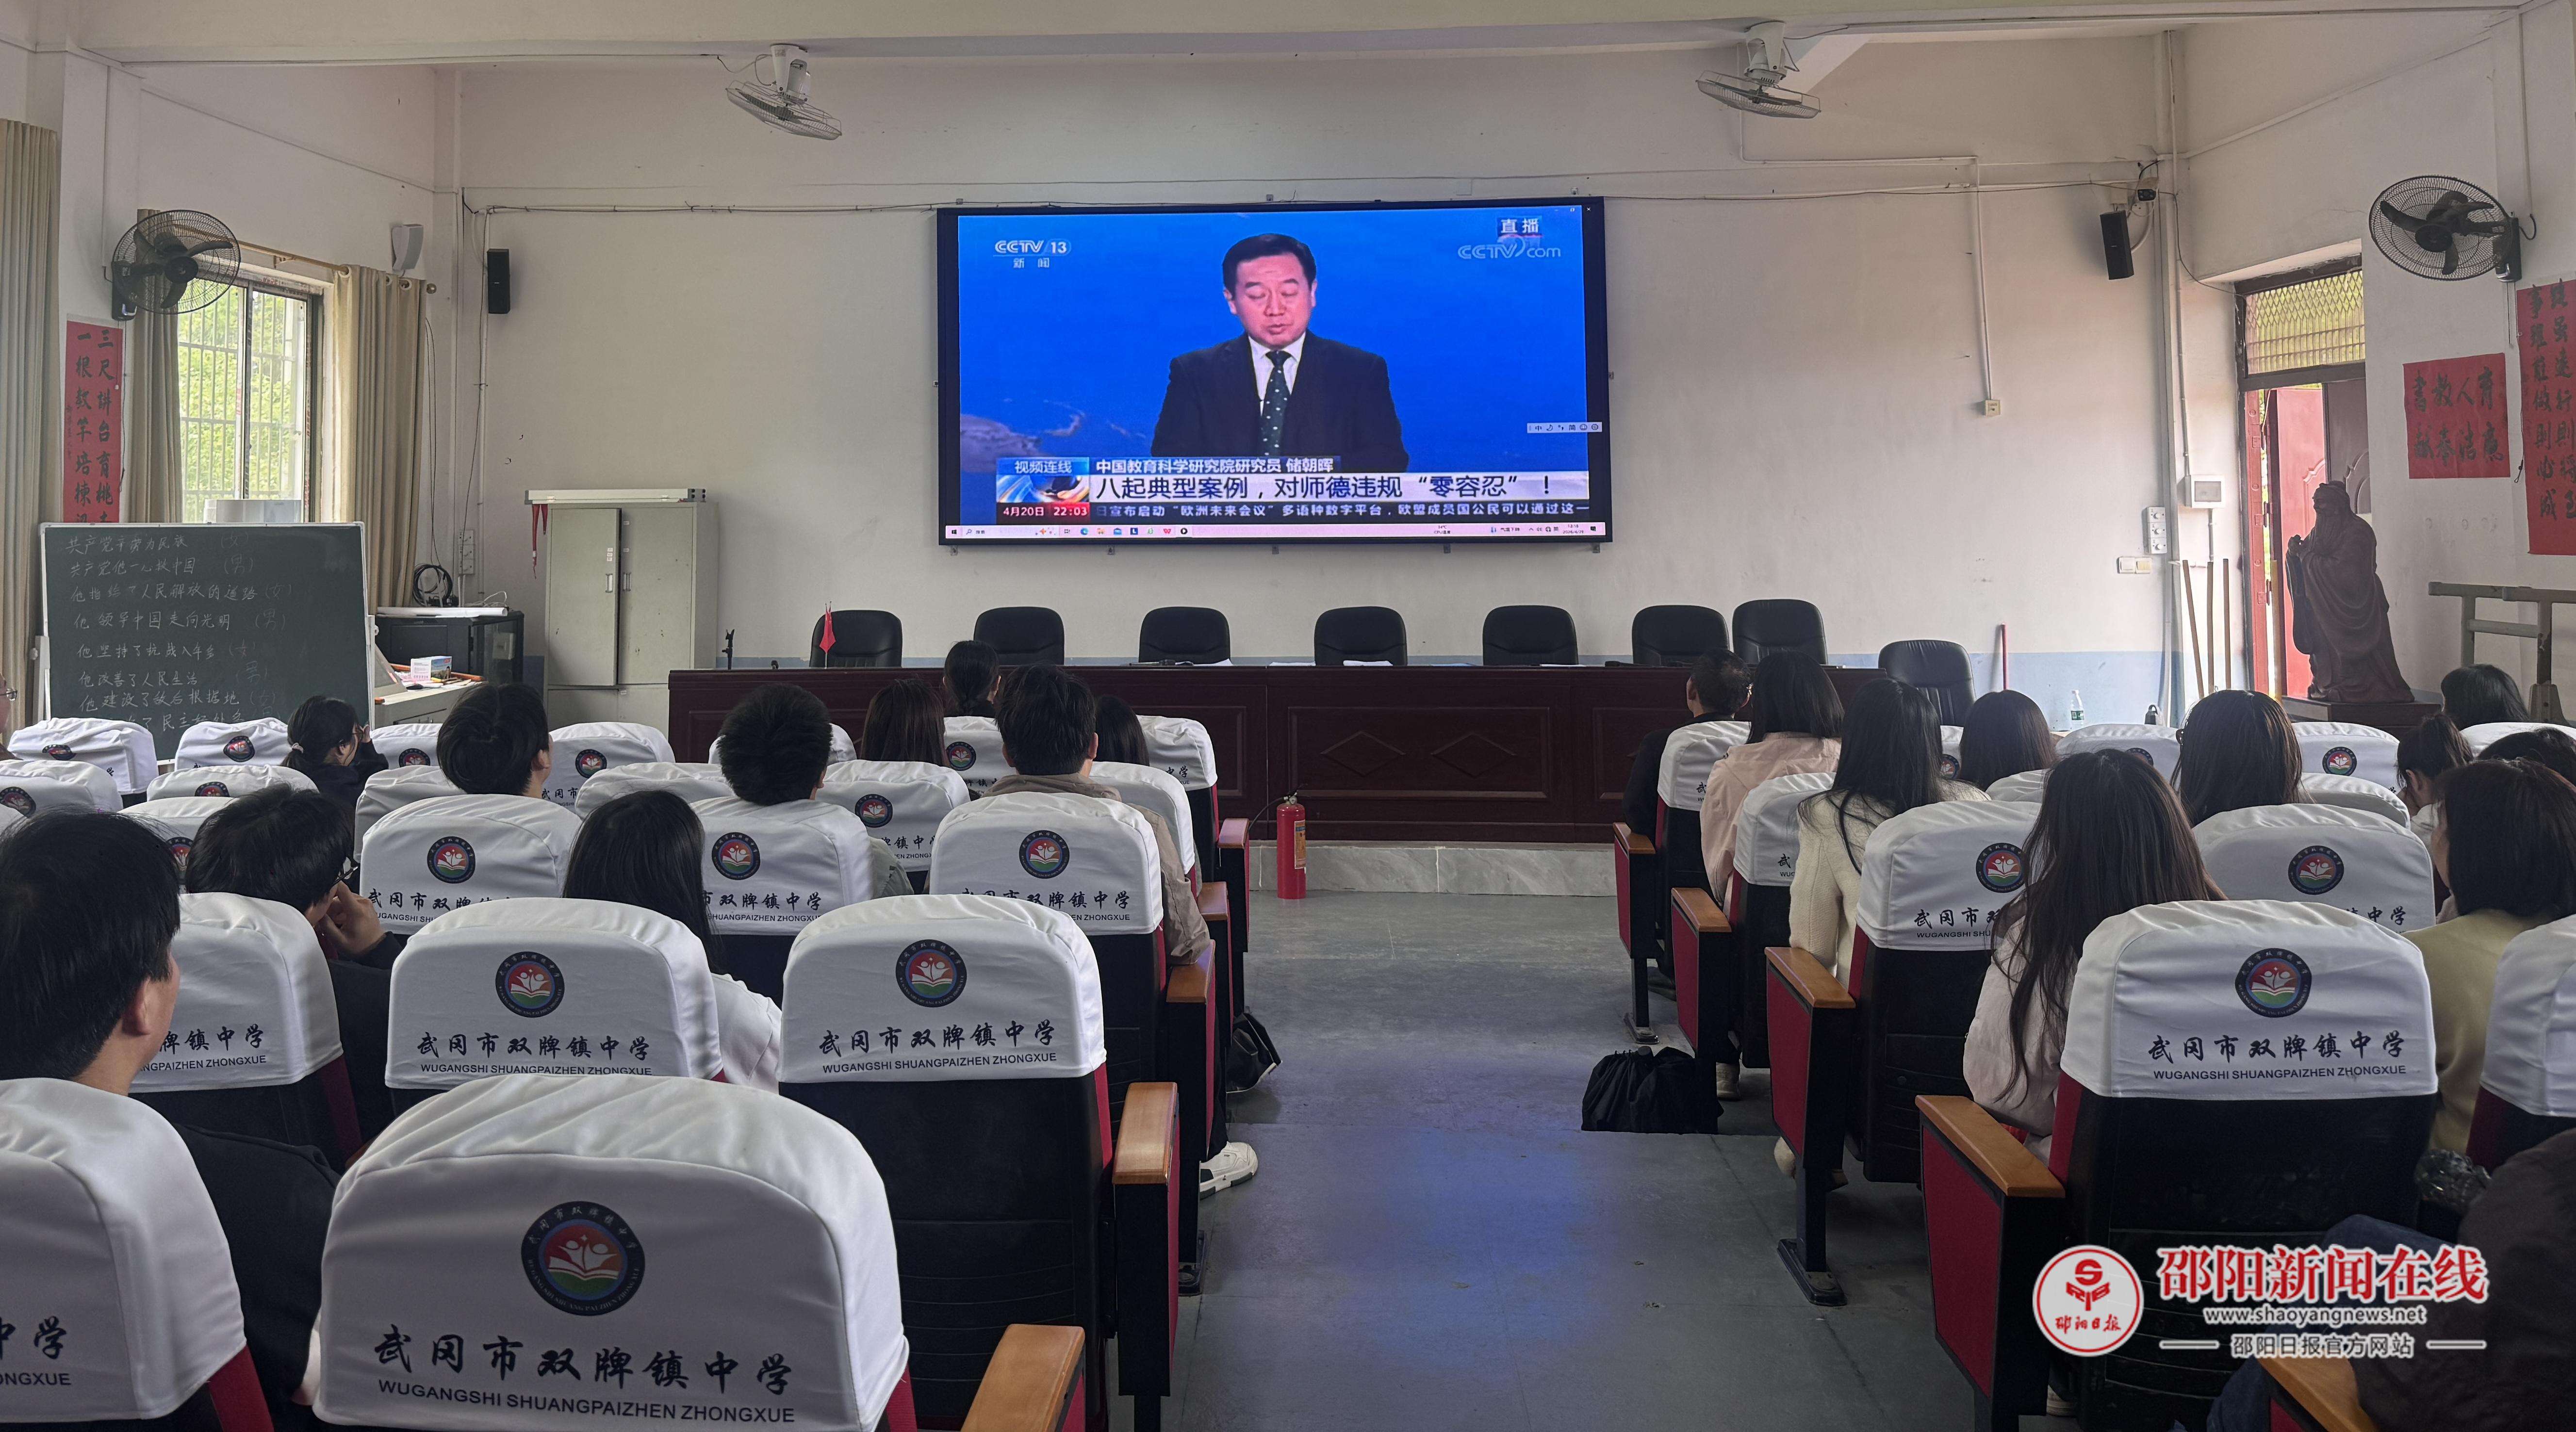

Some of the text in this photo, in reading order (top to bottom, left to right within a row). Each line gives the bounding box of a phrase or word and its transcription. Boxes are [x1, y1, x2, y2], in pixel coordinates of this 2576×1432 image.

[1501, 218, 1539, 233] 直播
[995, 240, 1067, 254] CCTV 13
[1013, 257, 1050, 268] 新闻
[1015, 461, 1072, 474] 视频连线
[1096, 458, 1281, 473] 中国教育科学研究院研究员
[1003, 506, 1088, 517] 4月20日 22:03
[70, 557, 195, 577] 共产党他一心救中国
[71, 582, 258, 602] 他指给了人民解放的道路
[74, 610, 230, 631] 他领导中国走向光明
[79, 671, 198, 687] 他改善了人民生活
[541, 787, 578, 800] 武冈市
[1778, 853, 1791, 869] 武
[377, 913, 418, 922] UGANGSHI
[417, 1031, 650, 1061] 武冈市双牌镇中学
[819, 1019, 1055, 1058] 武冈市双牌镇中学
[2148, 1029, 2407, 1065] 武冈市双牌镇中学
[206, 1055, 266, 1068] ZHONGXUE
[823, 1052, 1057, 1073] WUGANGSHI SHUANGPAIZHEN ZHONGXUE
[421, 1064, 652, 1075] WUGANGSHI SHUANGPAIZHEN ZHONGXUE
[2153, 1065, 2406, 1080] WUGANGSHI SHUANGPAIZHEN ZHONGXUE
[374, 1324, 793, 1396] 武冈市双牌镇中学
[378, 1379, 795, 1424] WUGANGSHI SHUANGPAIZHEN ZHONGXUE
